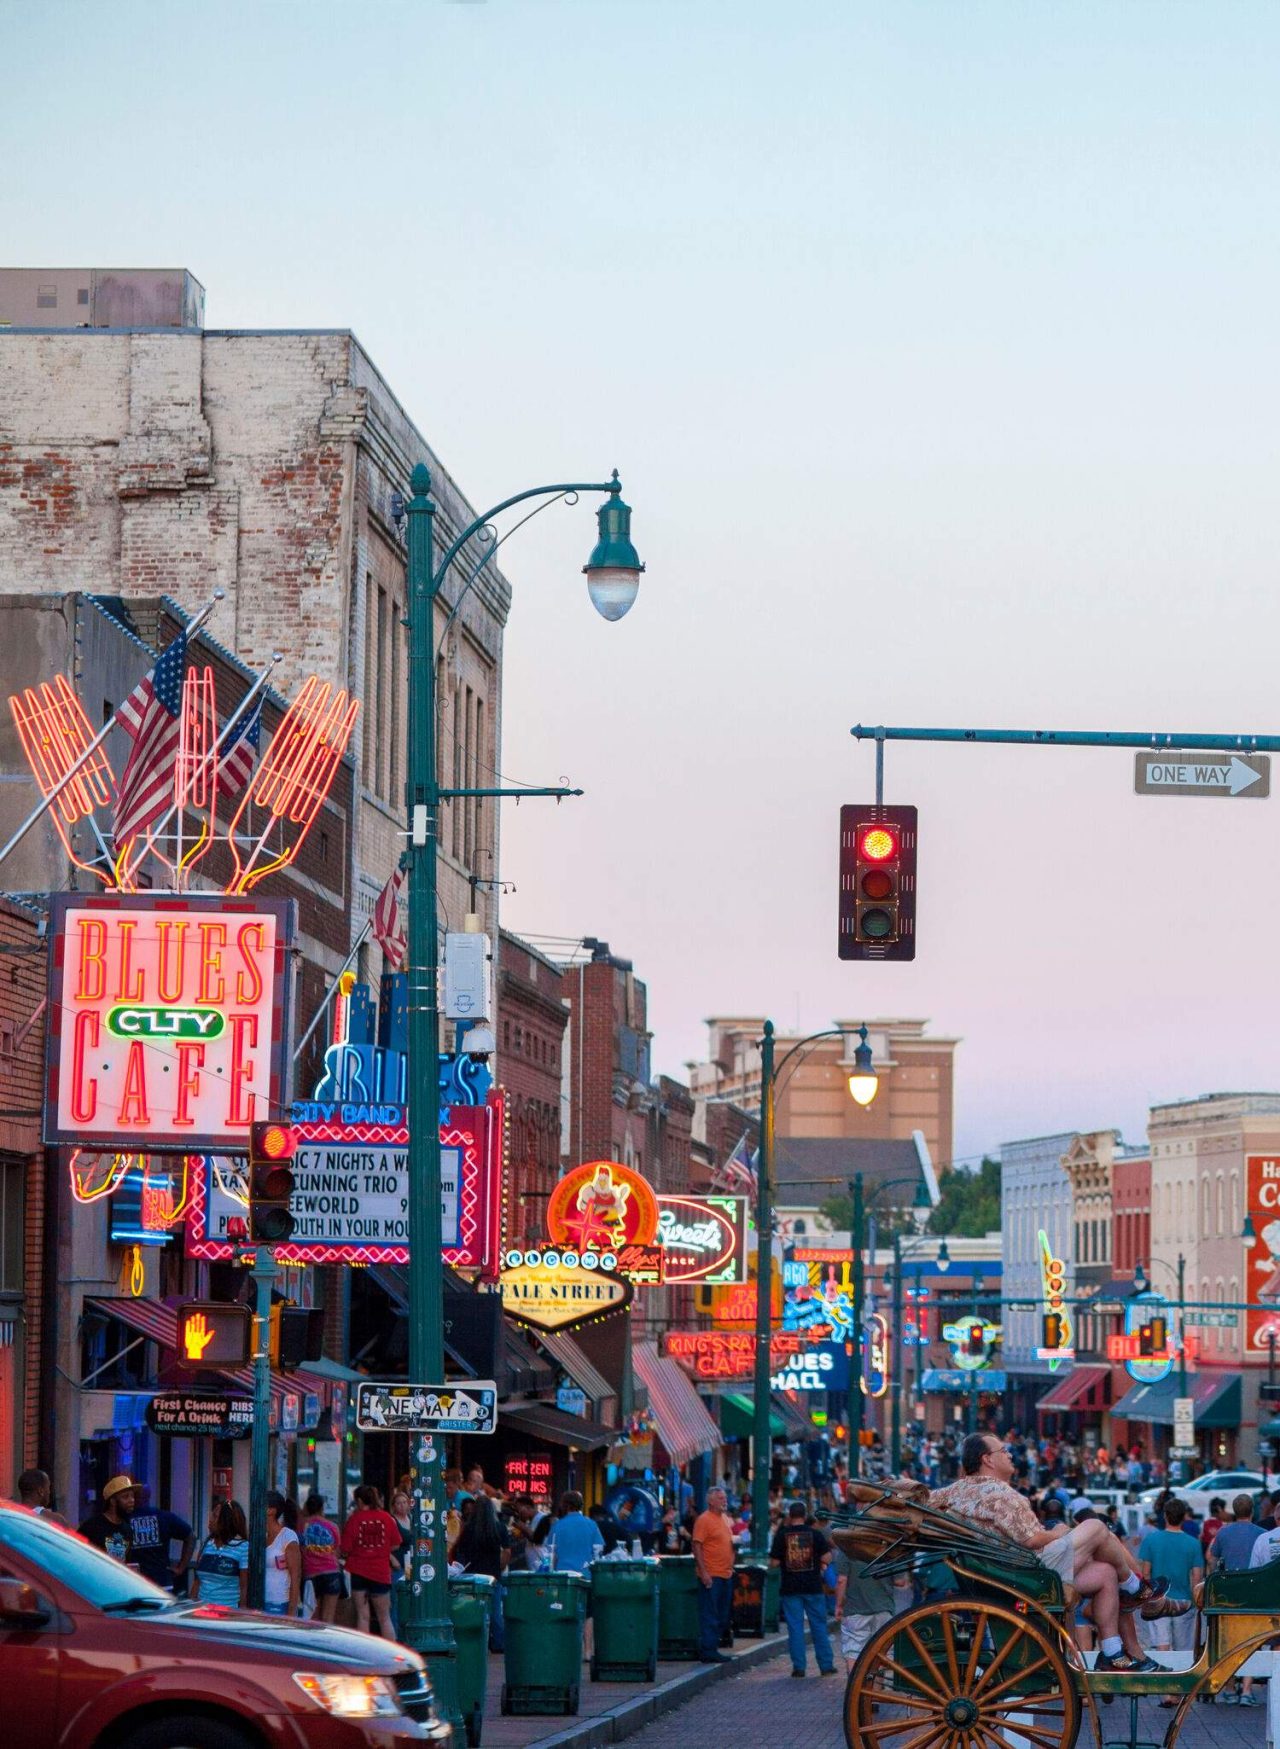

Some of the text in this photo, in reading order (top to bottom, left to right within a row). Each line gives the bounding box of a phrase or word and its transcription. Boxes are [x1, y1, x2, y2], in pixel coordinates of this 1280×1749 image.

[1151, 765, 1231, 783] ONE WAY
[74, 918, 265, 1005] BLUES
[118, 1010, 218, 1034] CITY
[71, 1009, 259, 1127] CAFE
[340, 1044, 478, 1105] BLS
[341, 1103, 402, 1126] BAND
[314, 1152, 320, 1171] 7
[327, 1152, 375, 1172] NIGHTS
[379, 1153, 388, 1172] A
[292, 1173, 359, 1194] CUNNING
[364, 1174, 397, 1194] TRIO
[289, 1195, 360, 1215] EEWORLD
[292, 1218, 409, 1238] OUTH IN YOUR MOU
[500, 1249, 618, 1271] ELCOME
[549, 1284, 617, 1299] STREET
[734, 1289, 758, 1304] TA
[720, 1304, 758, 1319] ROO
[669, 1335, 799, 1354] KING'S PAACE
[697, 1356, 757, 1375] CAF
[784, 1353, 834, 1371] UES
[153, 1399, 227, 1412] First Chance
[231, 1401, 254, 1412] RIBS
[157, 1411, 221, 1424] For A Drink
[229, 1412, 255, 1423] HERE
[155, 1423, 171, 1432] next
[171, 1423, 197, 1432] chance
[198, 1424, 208, 1432] 25
[508, 1462, 550, 1476] FROZEN
